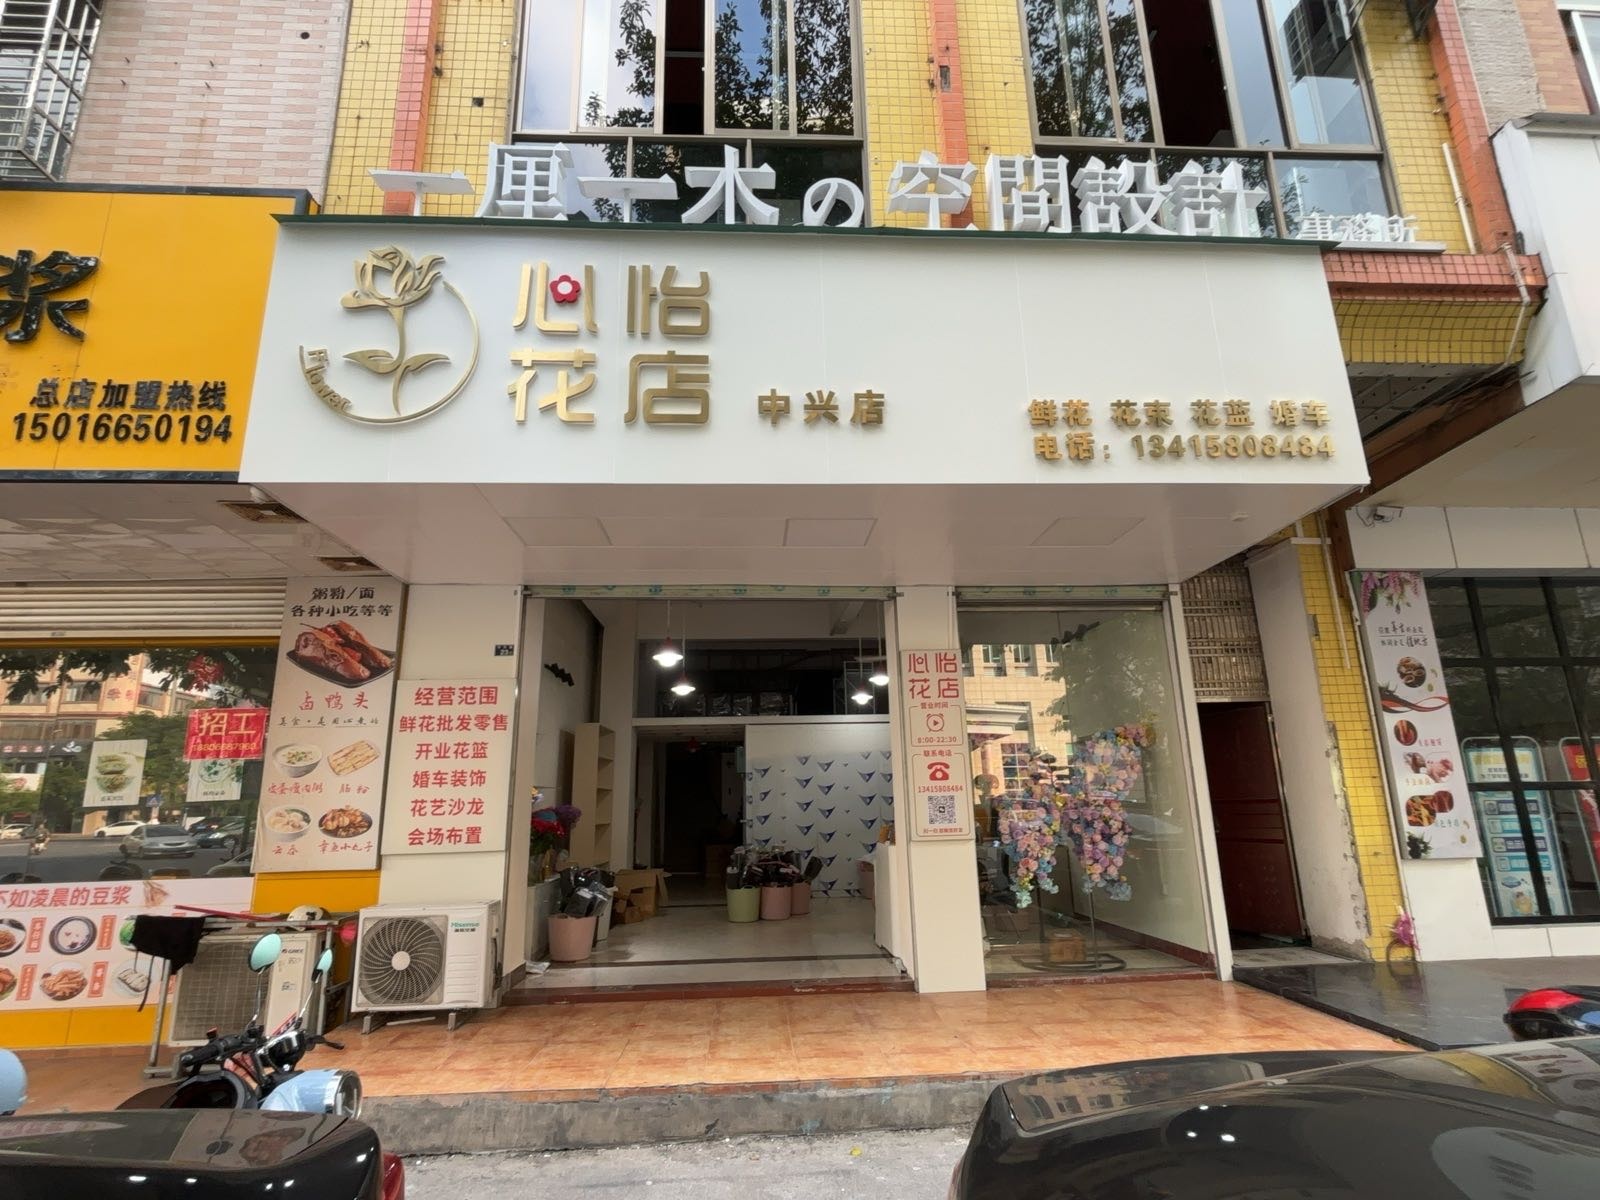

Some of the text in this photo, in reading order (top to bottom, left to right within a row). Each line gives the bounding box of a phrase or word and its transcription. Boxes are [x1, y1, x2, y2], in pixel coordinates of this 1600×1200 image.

[512, 261, 710, 338] 心怡
[30, 378, 226, 411] 总店加盟热线
[507, 348, 710, 425] 花店
[757, 388, 886, 427] 中兴店
[1028, 399, 1092, 427] 鲜花
[1109, 399, 1174, 427] 花束
[1270, 399, 1332, 427] 婚车
[13, 412, 232, 443] 15016650194
[1131, 434, 1336, 459] 13415808484
[290, 604, 393, 618] 各种小吃等等
[908, 652, 958, 673] 心怡
[414, 686, 498, 706] 经营范围
[908, 677, 960, 699] 花店
[198, 712, 257, 737] 招工
[399, 714, 509, 733] 鲜花批发零售
[415, 742, 489, 760] 开业花篮
[412, 769, 487, 788] 婚车装饰
[410, 799, 484, 817] 花艺沙龙
[408, 826, 482, 846] 会场布置
